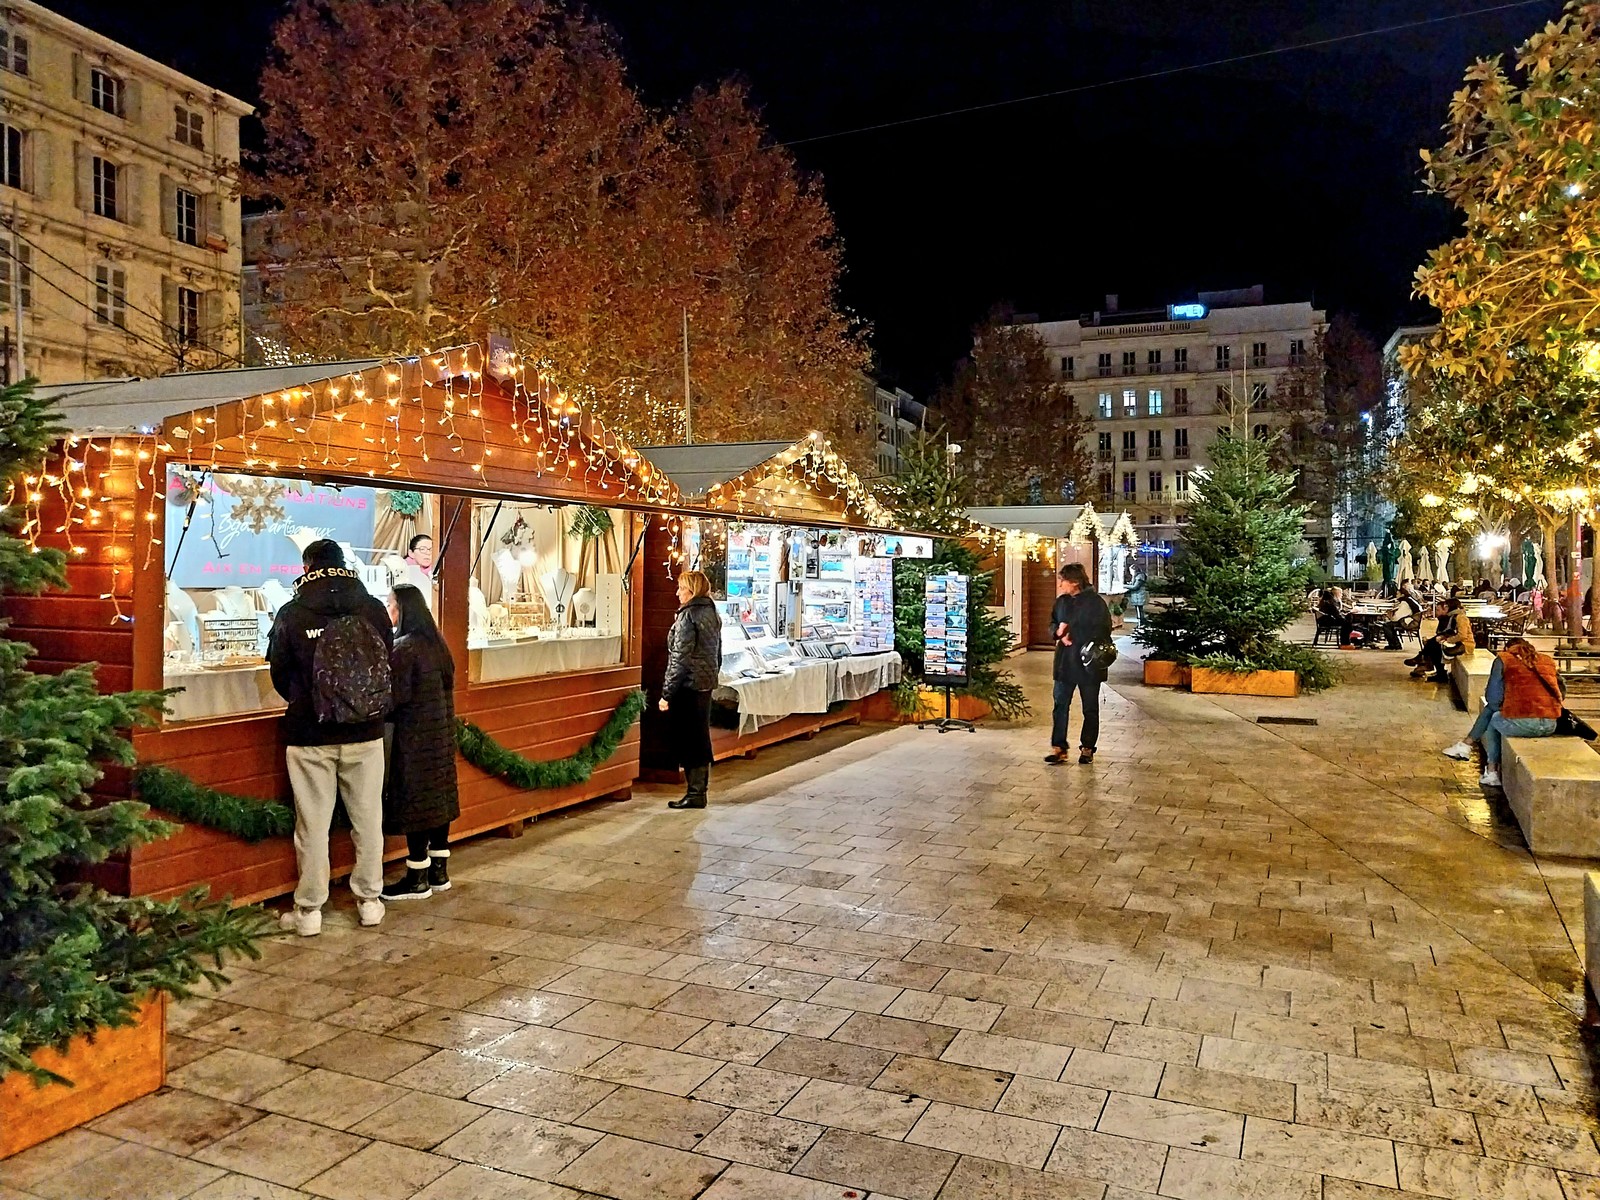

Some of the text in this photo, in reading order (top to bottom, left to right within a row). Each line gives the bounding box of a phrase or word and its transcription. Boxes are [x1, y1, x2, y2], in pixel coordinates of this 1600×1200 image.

[202, 561, 301, 575] AIX EN PRO
